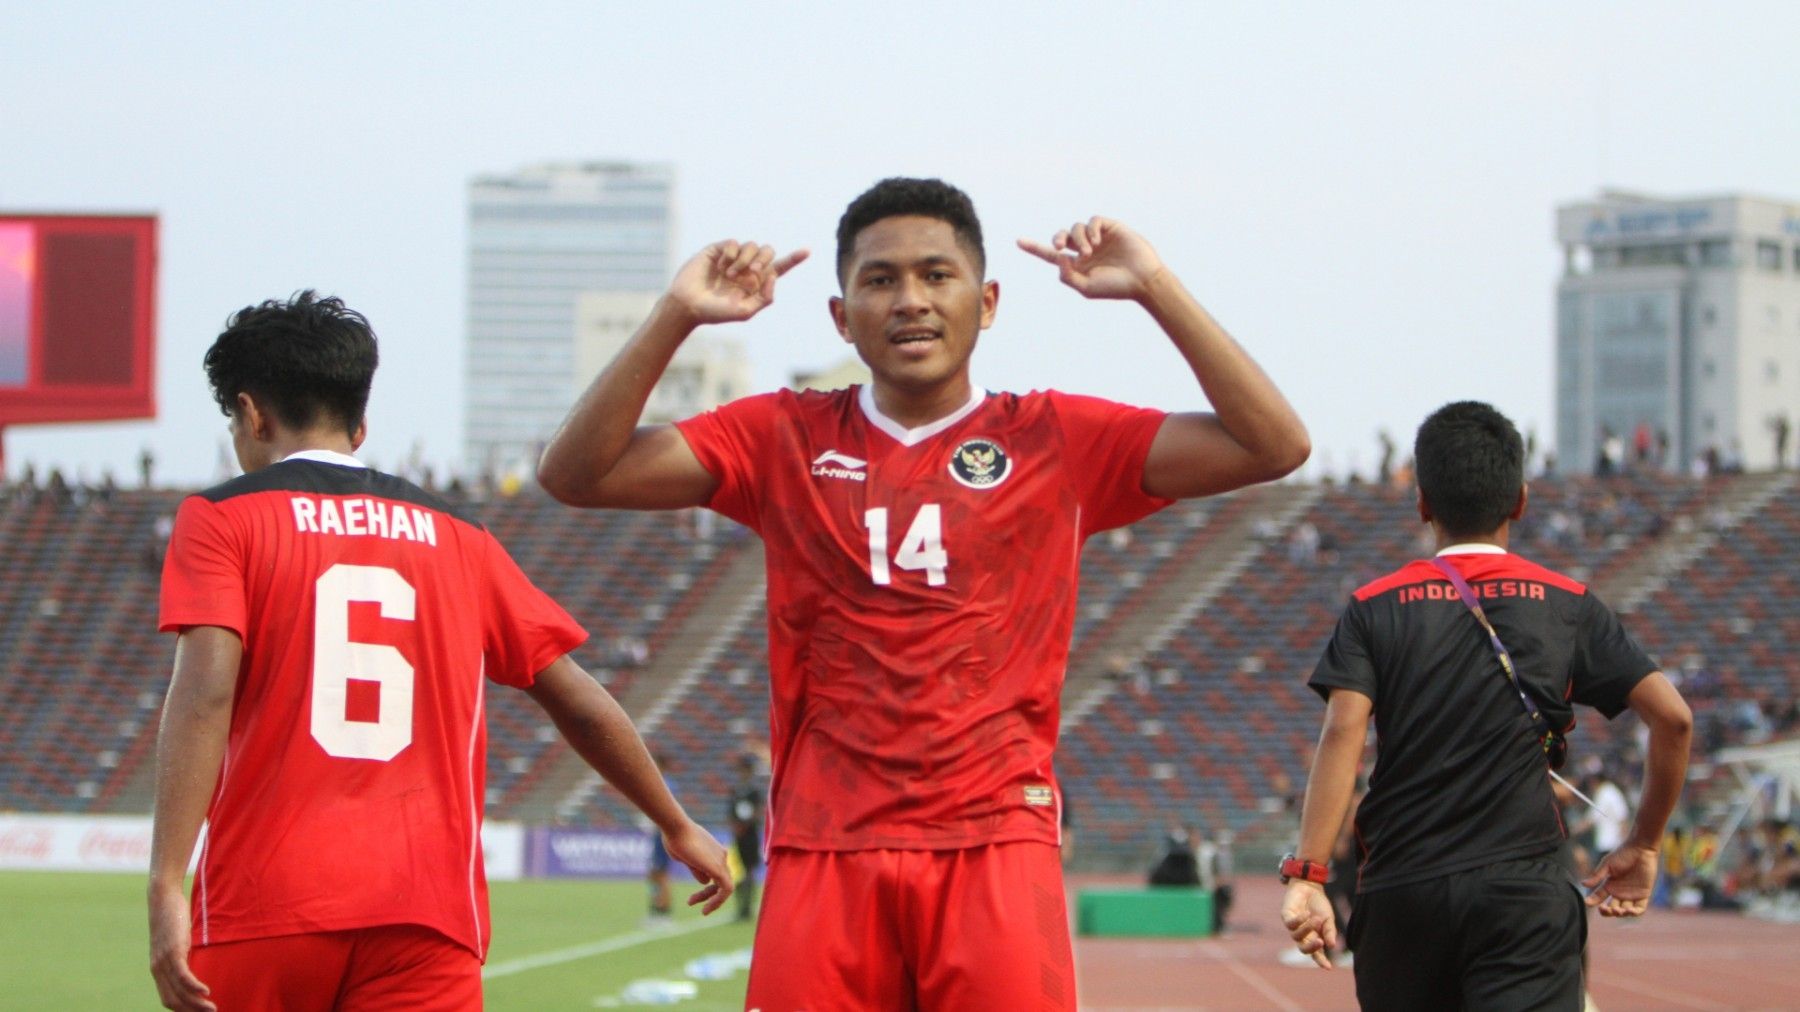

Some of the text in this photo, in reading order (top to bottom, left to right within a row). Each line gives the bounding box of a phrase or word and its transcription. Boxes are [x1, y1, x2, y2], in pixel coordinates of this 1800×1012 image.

[811, 465, 867, 481] LI-NING
[291, 496, 437, 547] RAEHAN
[864, 503, 948, 586] 14
[310, 563, 416, 762] 6
